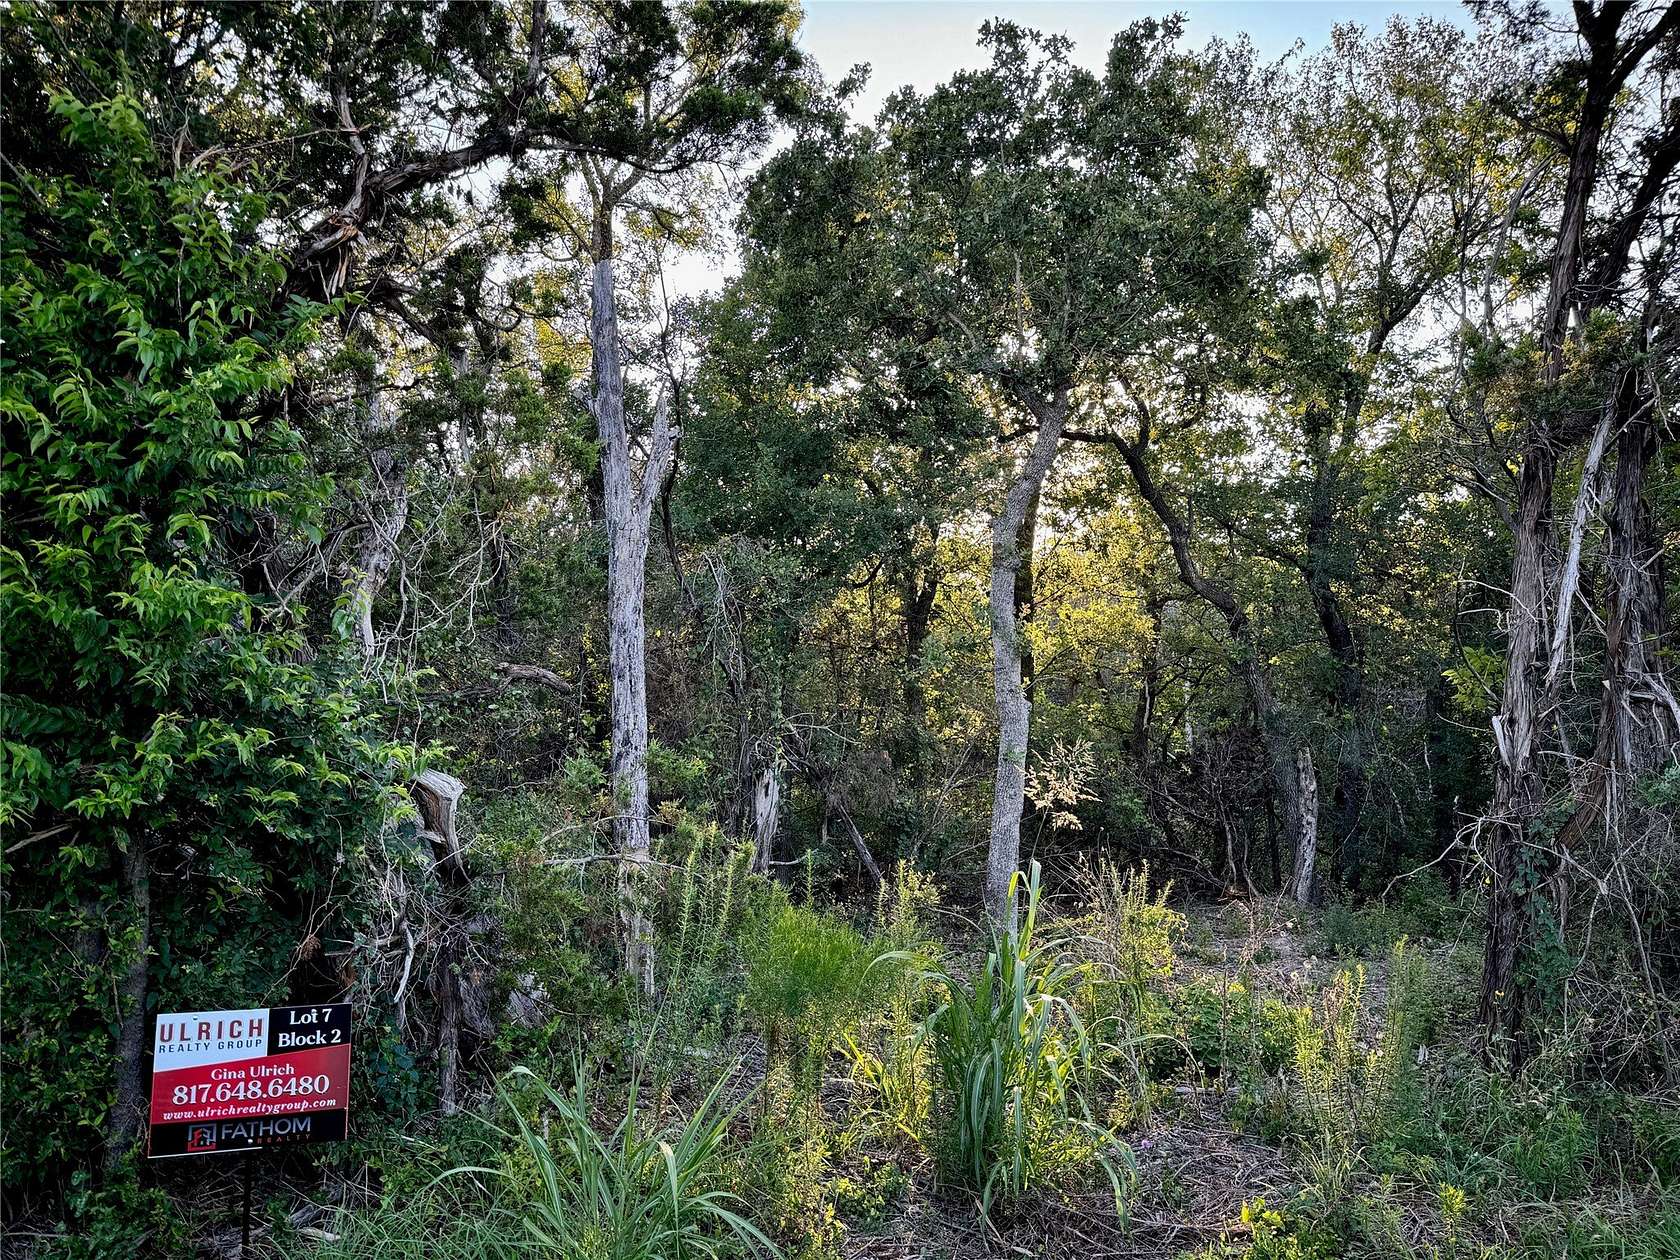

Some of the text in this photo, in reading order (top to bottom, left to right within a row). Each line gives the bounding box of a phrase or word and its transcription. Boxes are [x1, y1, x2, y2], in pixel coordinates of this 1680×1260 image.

[290, 1008, 333, 1025] Lot 7
[160, 1018, 263, 1043] ULRICH
[278, 1028, 342, 1047] Block 2
[159, 1038, 262, 1054] REALTY GROUP
[211, 1063, 295, 1081] Gina Ulrich
[172, 1074, 330, 1106] 817.648.6480
[163, 1098, 337, 1120] www.ulrichrealtygroup.com
[221, 1116, 311, 1140] FATHOM
[257, 1133, 311, 1144] REALTY
